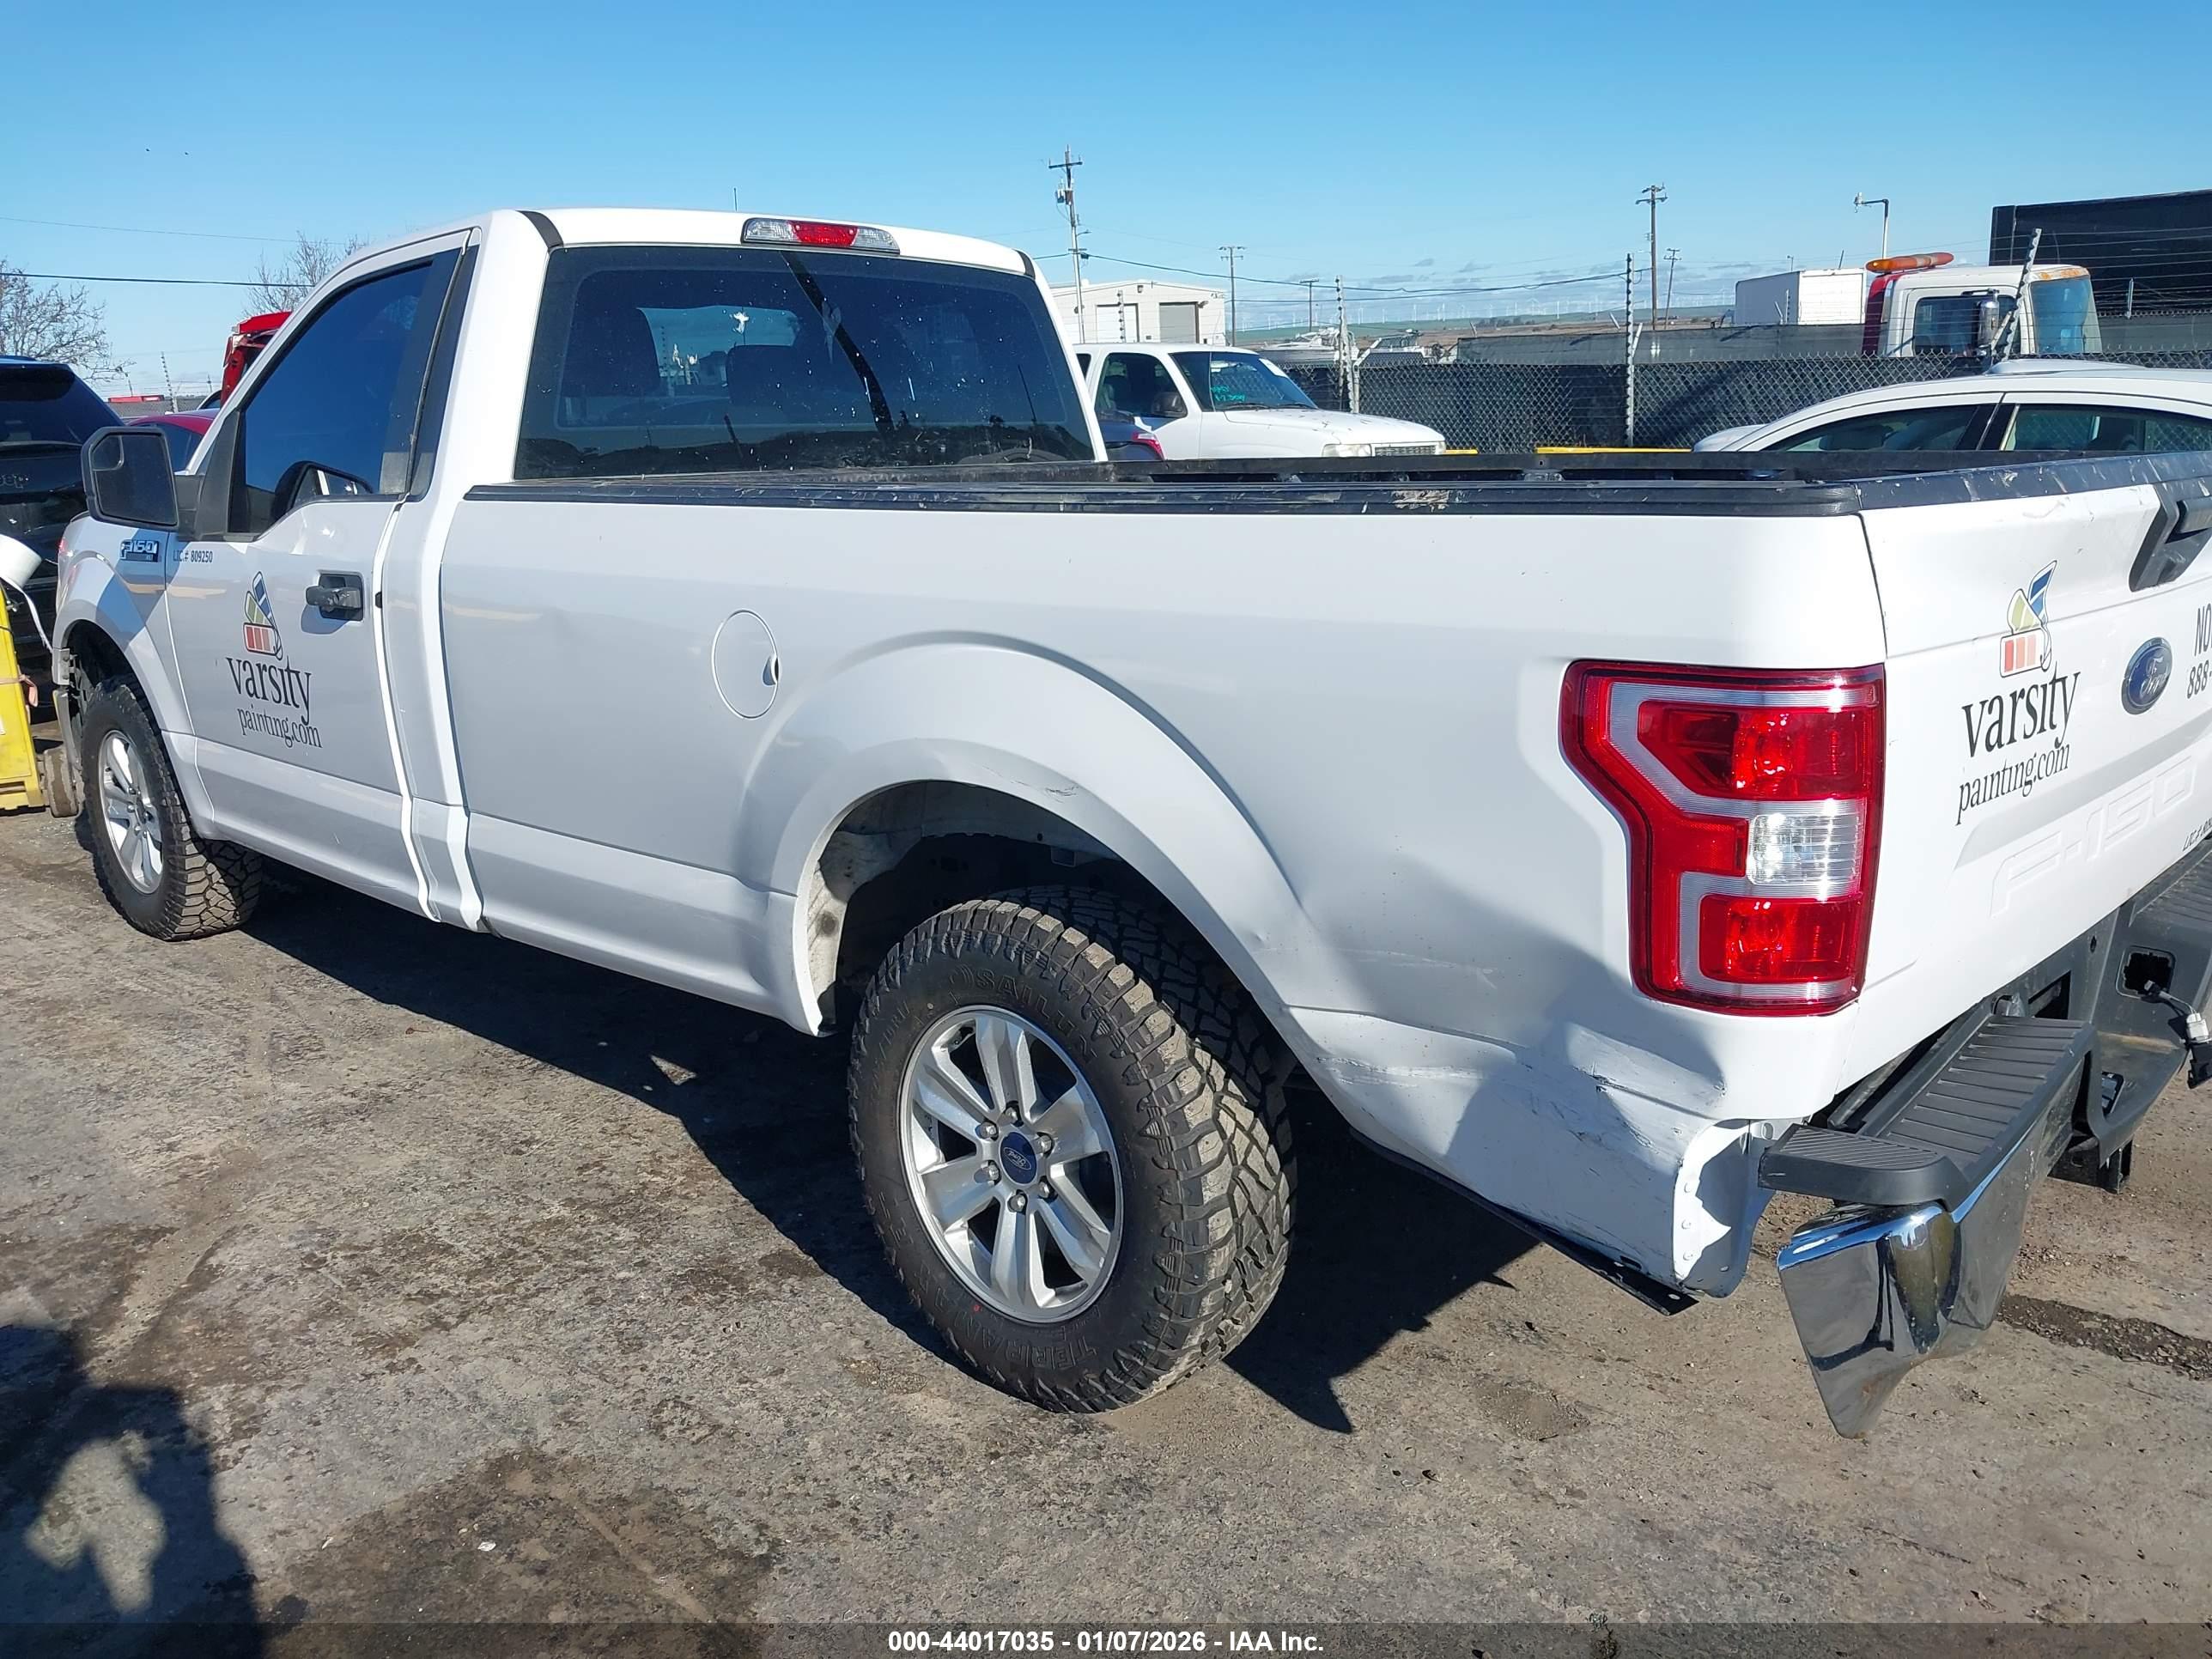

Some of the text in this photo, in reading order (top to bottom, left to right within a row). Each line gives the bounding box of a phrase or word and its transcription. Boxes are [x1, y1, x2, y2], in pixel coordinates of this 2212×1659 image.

[190, 550, 214, 563] 809250
[2194, 603, 2212, 657] NO
[226, 655, 312, 726] varsity
[237, 704, 323, 748] painting.com
[1961, 661, 2081, 757] varsity
[1956, 744, 2070, 825] painting.com
[1990, 755, 2197, 919] F-150
